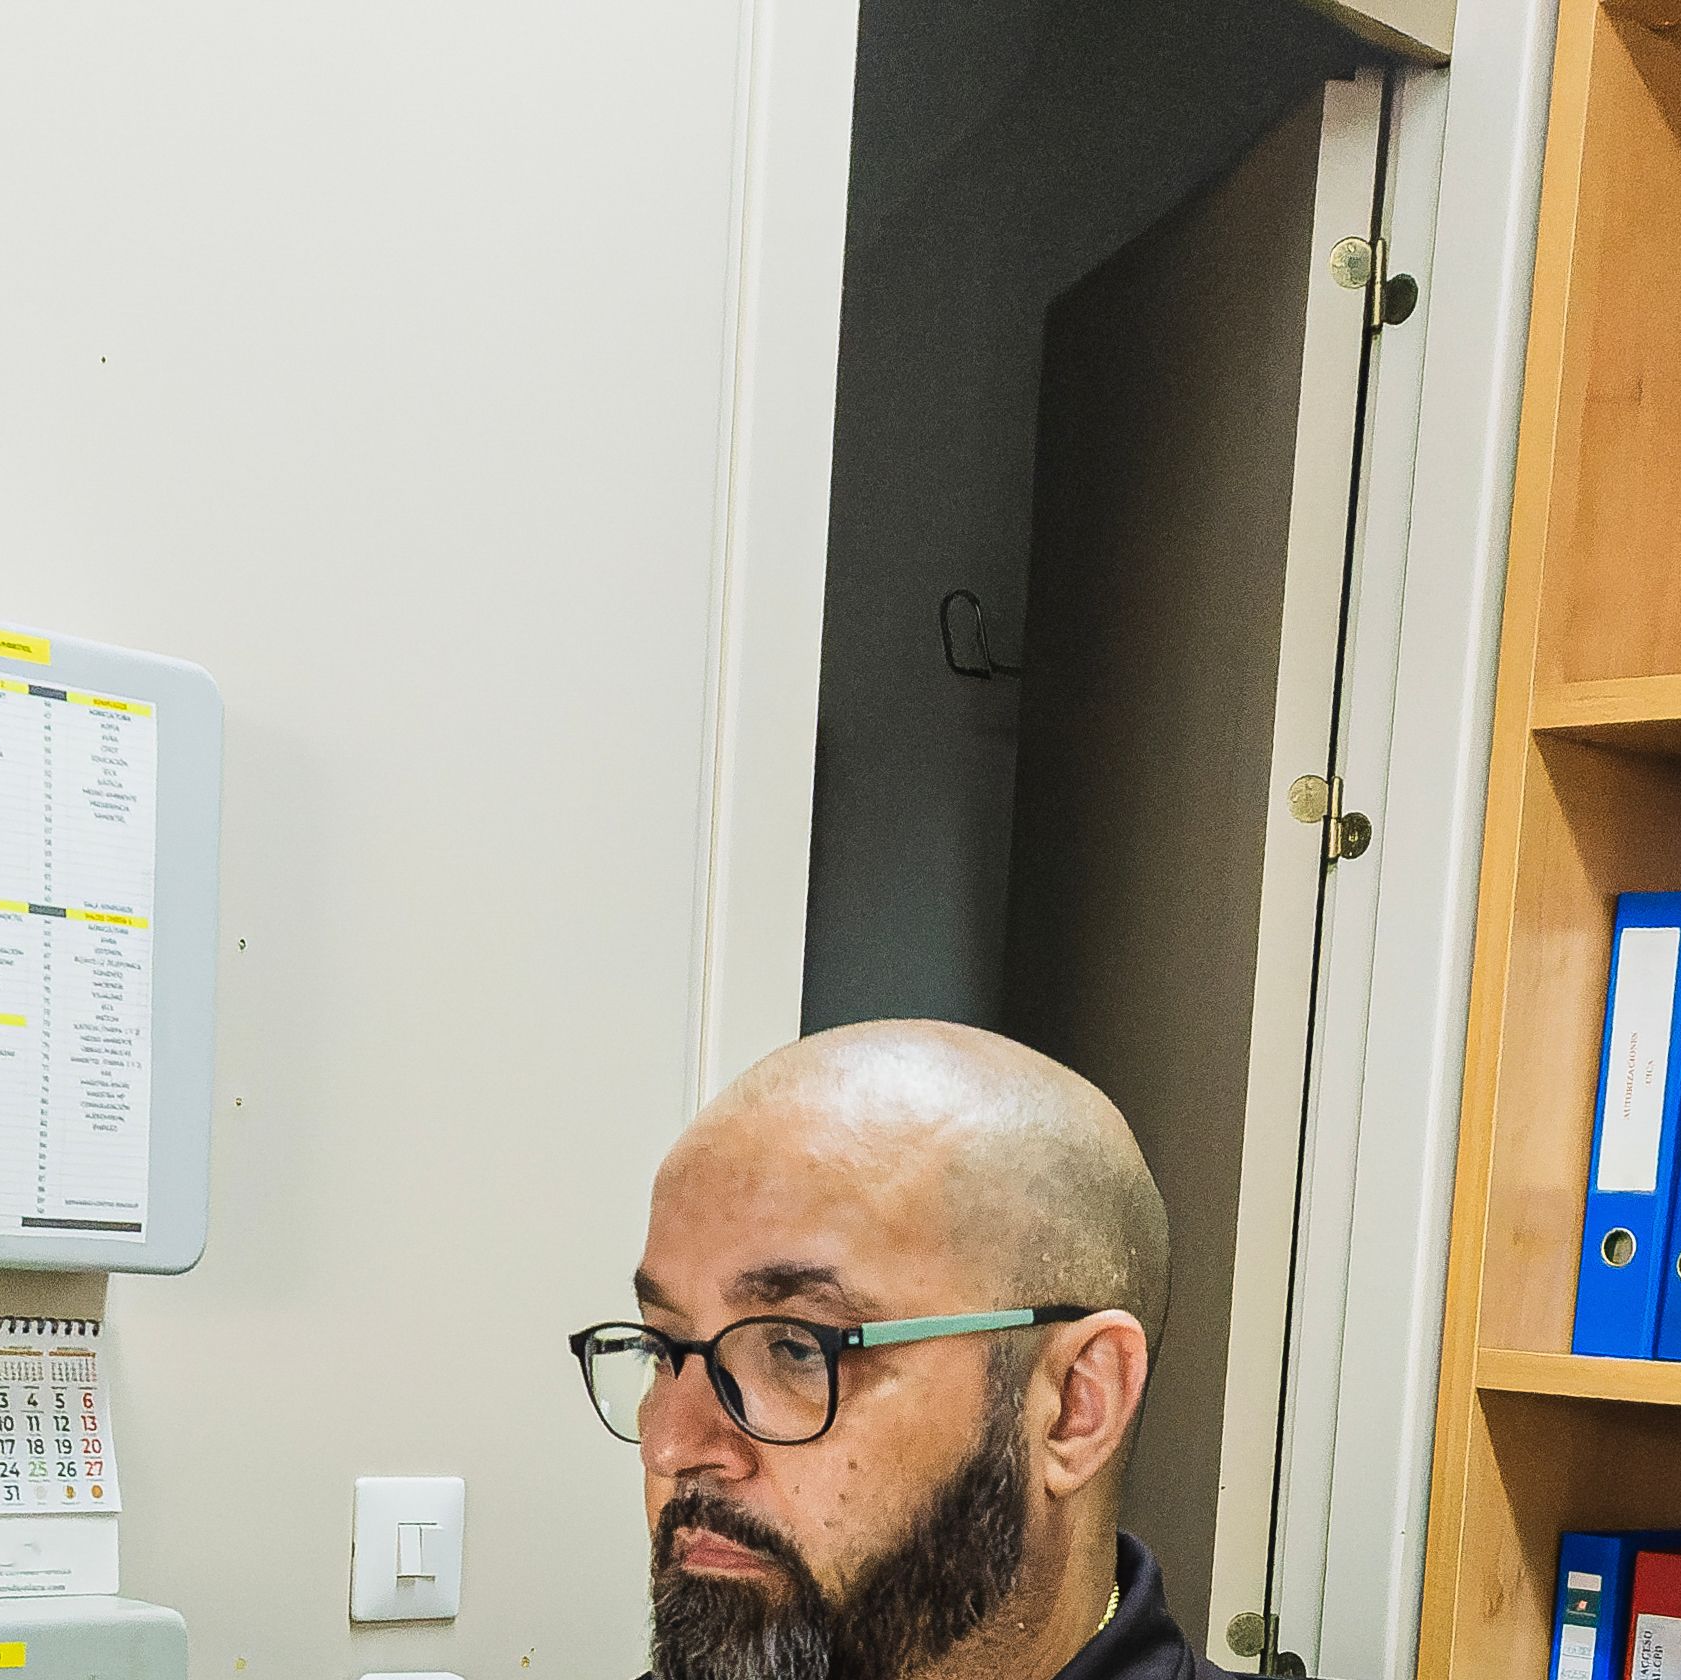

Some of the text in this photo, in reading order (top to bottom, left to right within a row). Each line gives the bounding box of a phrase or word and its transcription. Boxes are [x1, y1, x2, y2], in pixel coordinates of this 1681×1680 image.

[1623, 1031, 1638, 1121] AUTORIZACIONES
[0, 1392, 9, 1409] 3
[27, 1392, 38, 1407] 4
[55, 1392, 65, 1409] 5
[83, 1392, 94, 1409] 6
[26, 1415, 40, 1432] 11
[53, 1415, 70, 1432] 12
[81, 1415, 97, 1431] 13
[26, 1438, 44, 1455] 18
[55, 1438, 72, 1455] 19
[82, 1438, 102, 1454] 20
[0, 1462, 20, 1478] 24
[29, 1462, 48, 1478] 25
[56, 1461, 77, 1477] 26
[84, 1461, 103, 1477] 27
[4, 1485, 20, 1501] 31
[1639, 1630, 1653, 1675] ACCESO
